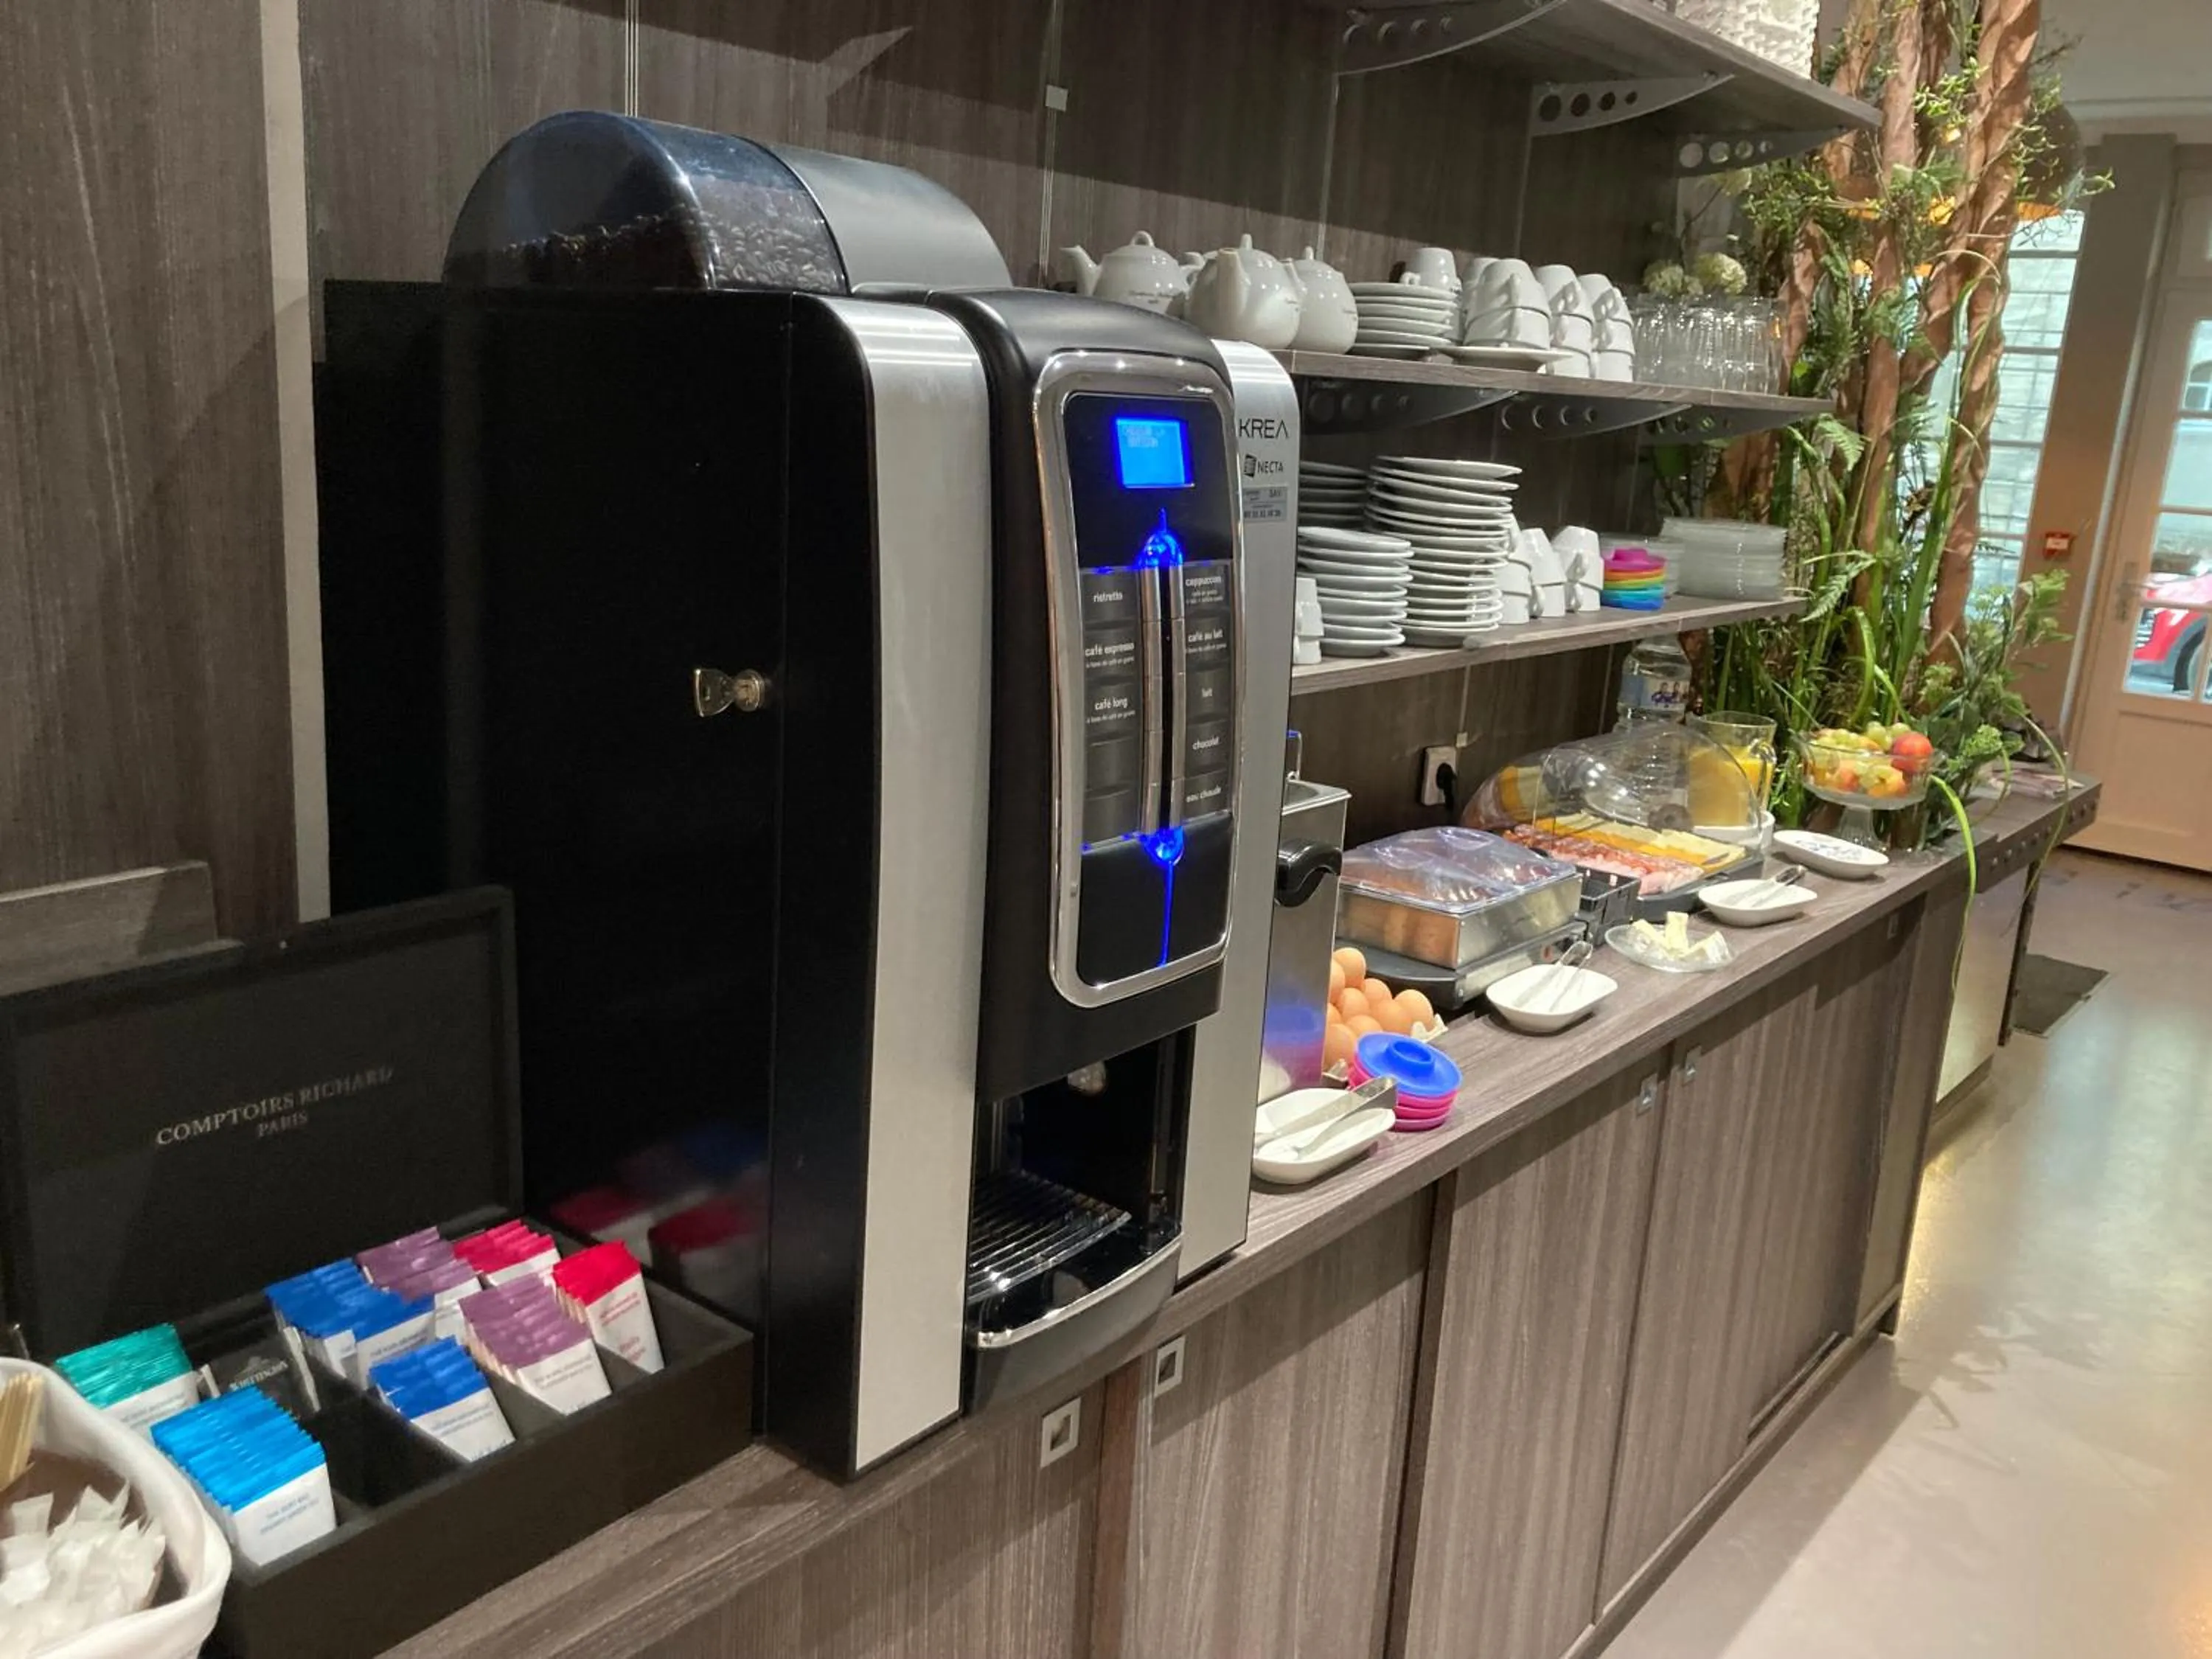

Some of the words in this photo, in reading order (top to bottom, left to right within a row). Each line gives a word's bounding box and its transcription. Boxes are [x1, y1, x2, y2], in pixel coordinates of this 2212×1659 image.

[1239, 418, 1289, 439] KREA
[1257, 460, 1284, 473] NECTA
[1093, 590, 1124, 602] ristretto
[1188, 630, 1203, 643] café
[1204, 632, 1213, 641] au
[1085, 643, 1103, 657] café
[1094, 698, 1112, 711] café
[1112, 696, 1128, 709] long
[156, 1093, 295, 1145] COMPTOIRS
[298, 1065, 395, 1106] RICHARD
[258, 1110, 309, 1138] PARIS
